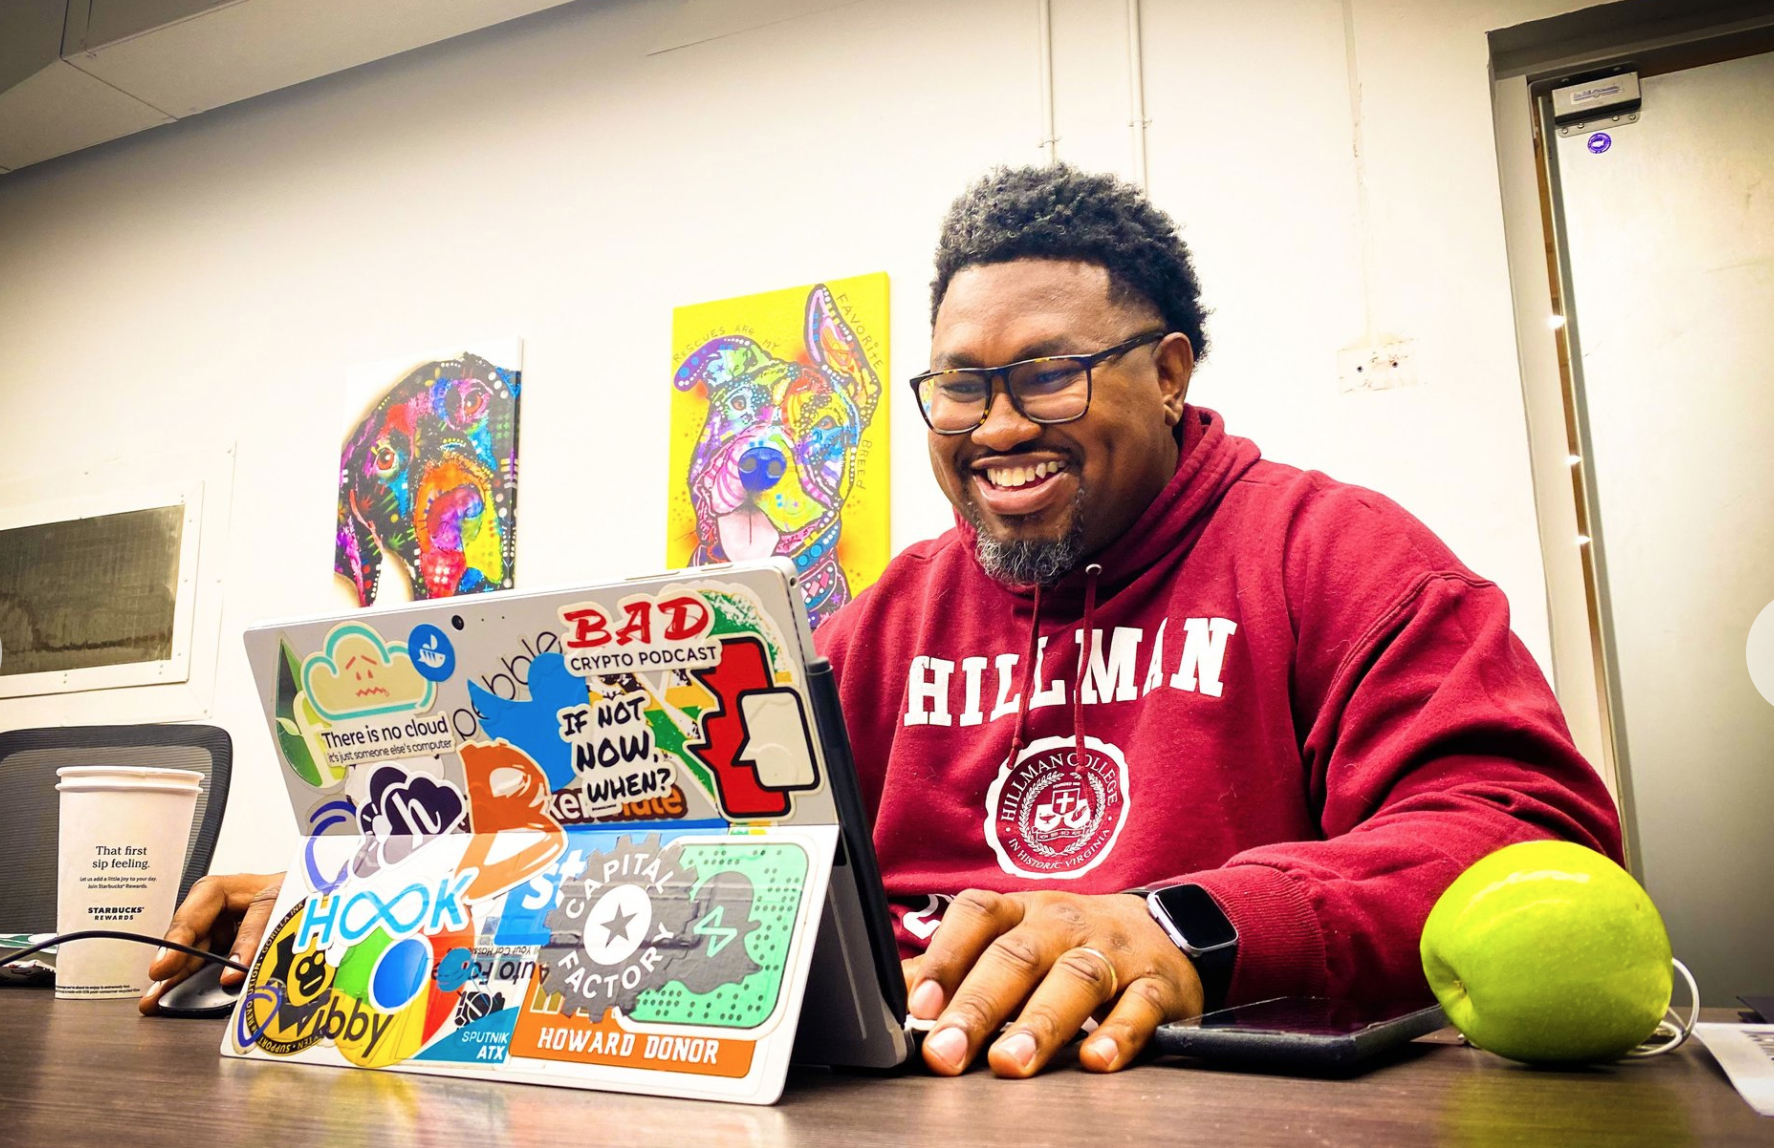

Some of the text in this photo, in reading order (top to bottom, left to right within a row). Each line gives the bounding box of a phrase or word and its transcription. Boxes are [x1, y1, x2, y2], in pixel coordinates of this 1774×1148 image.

[563, 596, 709, 648] BAD
[570, 646, 718, 672] CRYPTO PODCAST
[903, 617, 1238, 728] HILLMAN
[321, 716, 449, 749] There is no cloud
[562, 696, 646, 736] IF NOT
[327, 739, 453, 764] it's just someone else's computer
[576, 731, 660, 771] NOW,
[587, 768, 671, 804] WHEN?
[1001, 753, 1064, 821] HILLMAN
[92, 859, 150, 871] sip feeling.
[95, 846, 148, 856] That first
[1008, 838, 1021, 852] IN
[1017, 849, 1063, 870] HISTORIC
[1065, 829, 1111, 868] VIRGINIA
[565, 852, 675, 920] CAPITAL
[261, 916, 290, 954] GORILLA
[499, 961, 551, 986] Auto
[557, 921, 675, 999] FACTORY
[258, 1036, 292, 1053] SUPPORT
[461, 1030, 510, 1045] SPUTNIK
[476, 1045, 506, 1061] ATX
[537, 1026, 720, 1065] HOWARD DONOR
